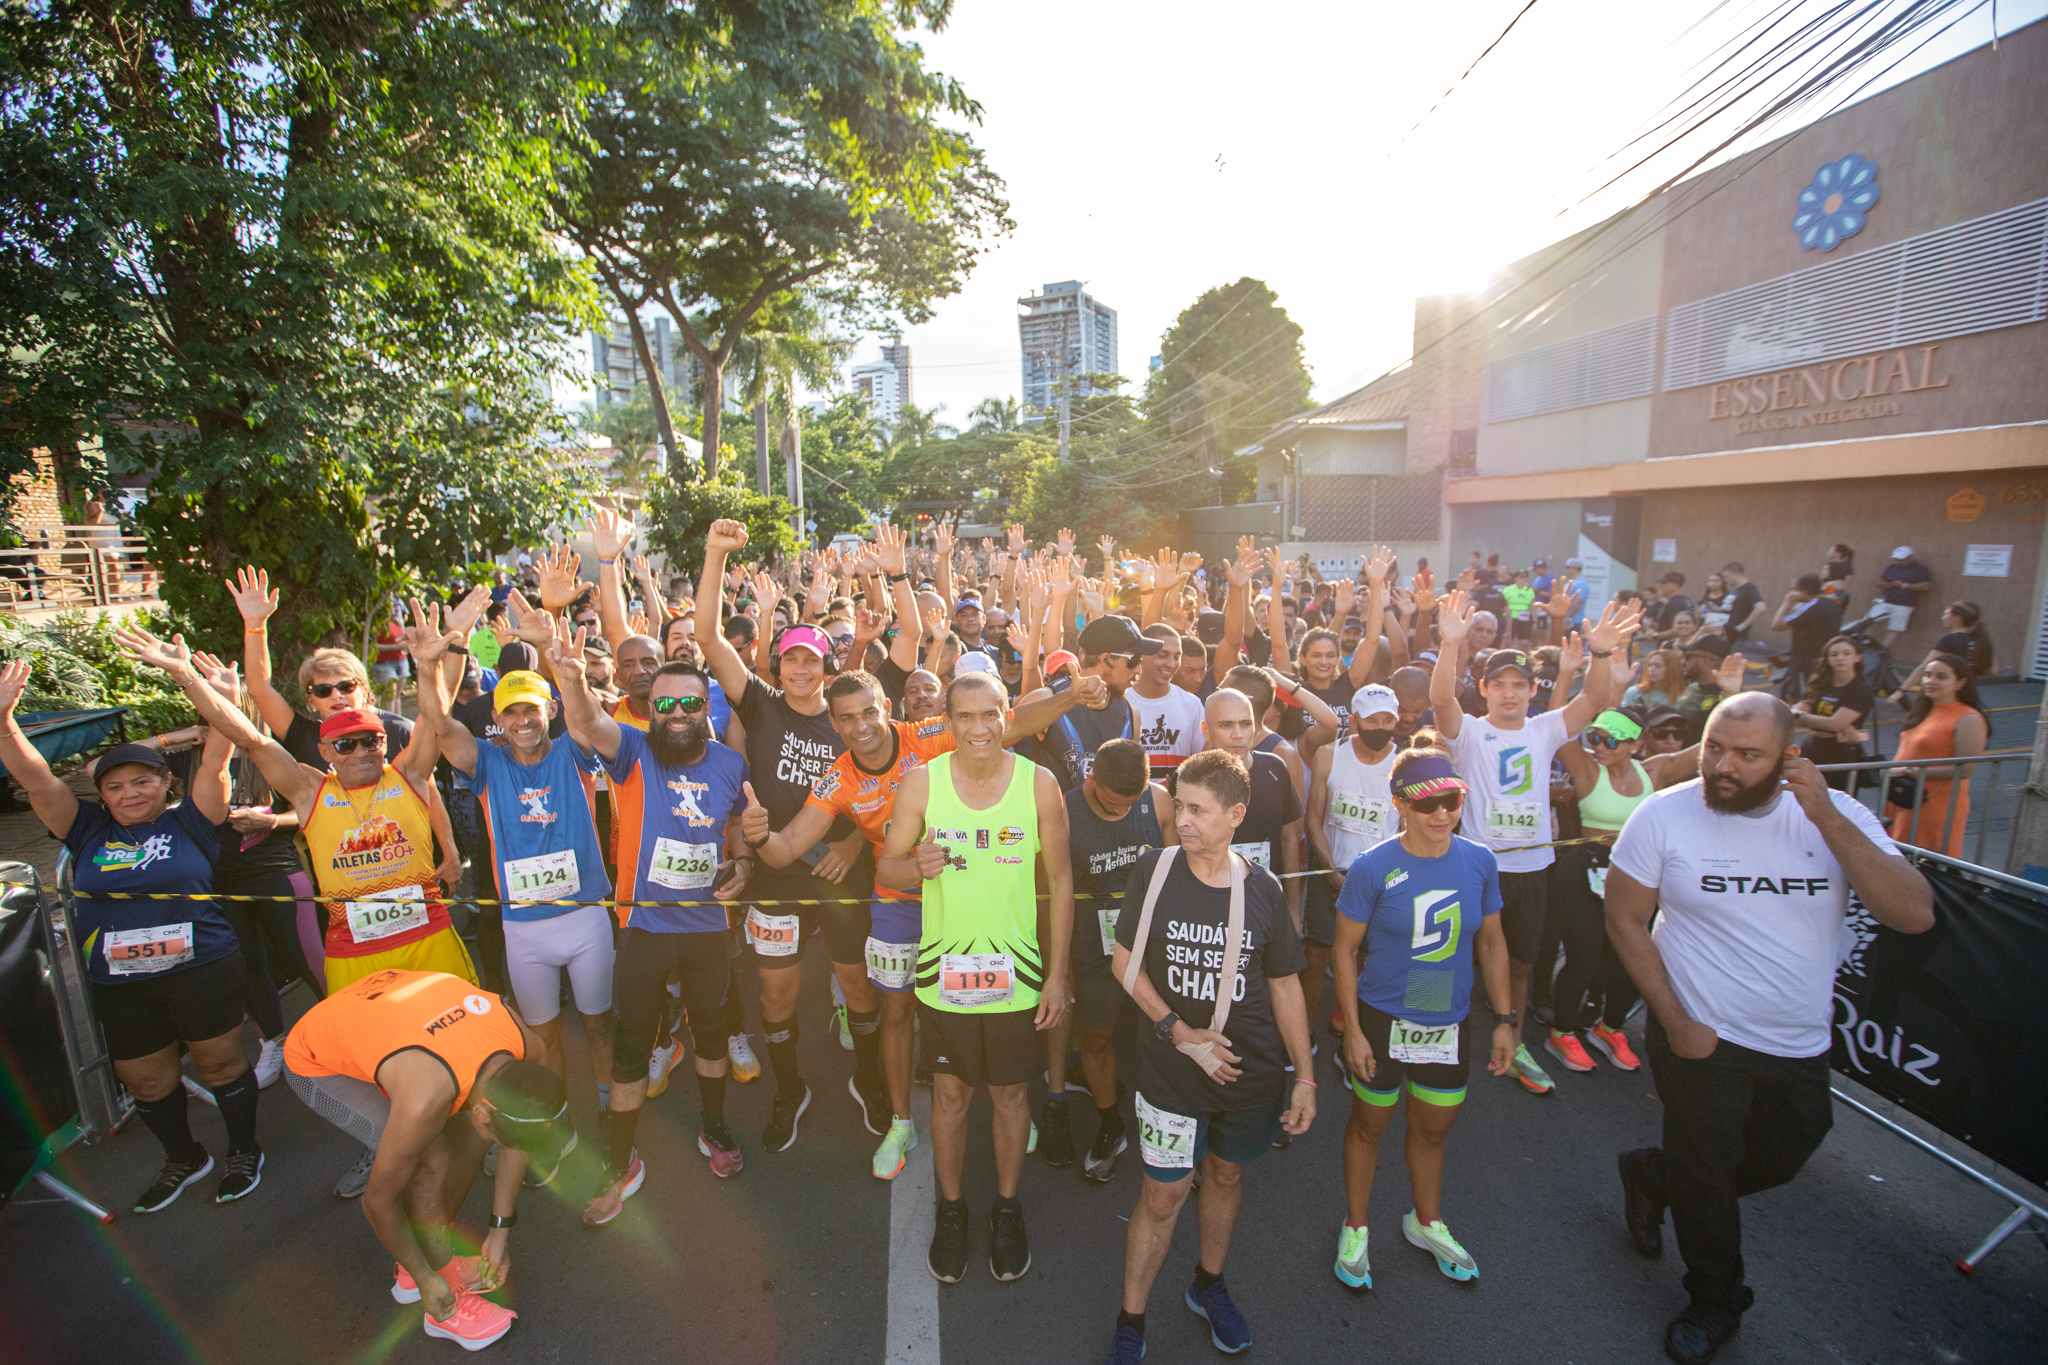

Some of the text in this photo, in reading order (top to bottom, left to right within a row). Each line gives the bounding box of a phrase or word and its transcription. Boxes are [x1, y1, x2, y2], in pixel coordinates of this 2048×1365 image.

[1708, 345, 1950, 420] ESSENCIAL
[800, 756, 821, 774] SER
[667, 781, 709, 791] EQUIPE
[689, 816, 715, 827] CHÃO
[1342, 803, 1378, 822] 1012
[1497, 814, 1534, 826] 1142
[105, 850, 138, 861] TRE
[332, 845, 415, 869] ATLETAS 60+
[666, 856, 709, 873] 1236
[1090, 853, 1137, 874] do Asfalto
[520, 868, 567, 888] 1124
[1701, 875, 1829, 896] STAFF
[363, 904, 413, 925] 1065
[756, 926, 783, 942] 120
[127, 942, 167, 959] 551
[1167, 945, 1223, 969] SEM SE
[874, 955, 907, 971] 1111
[960, 972, 996, 988] 119
[426, 1009, 466, 1036] CTJM
[1401, 1029, 1446, 1044] 1077
[1832, 992, 1941, 1086] Raiz
